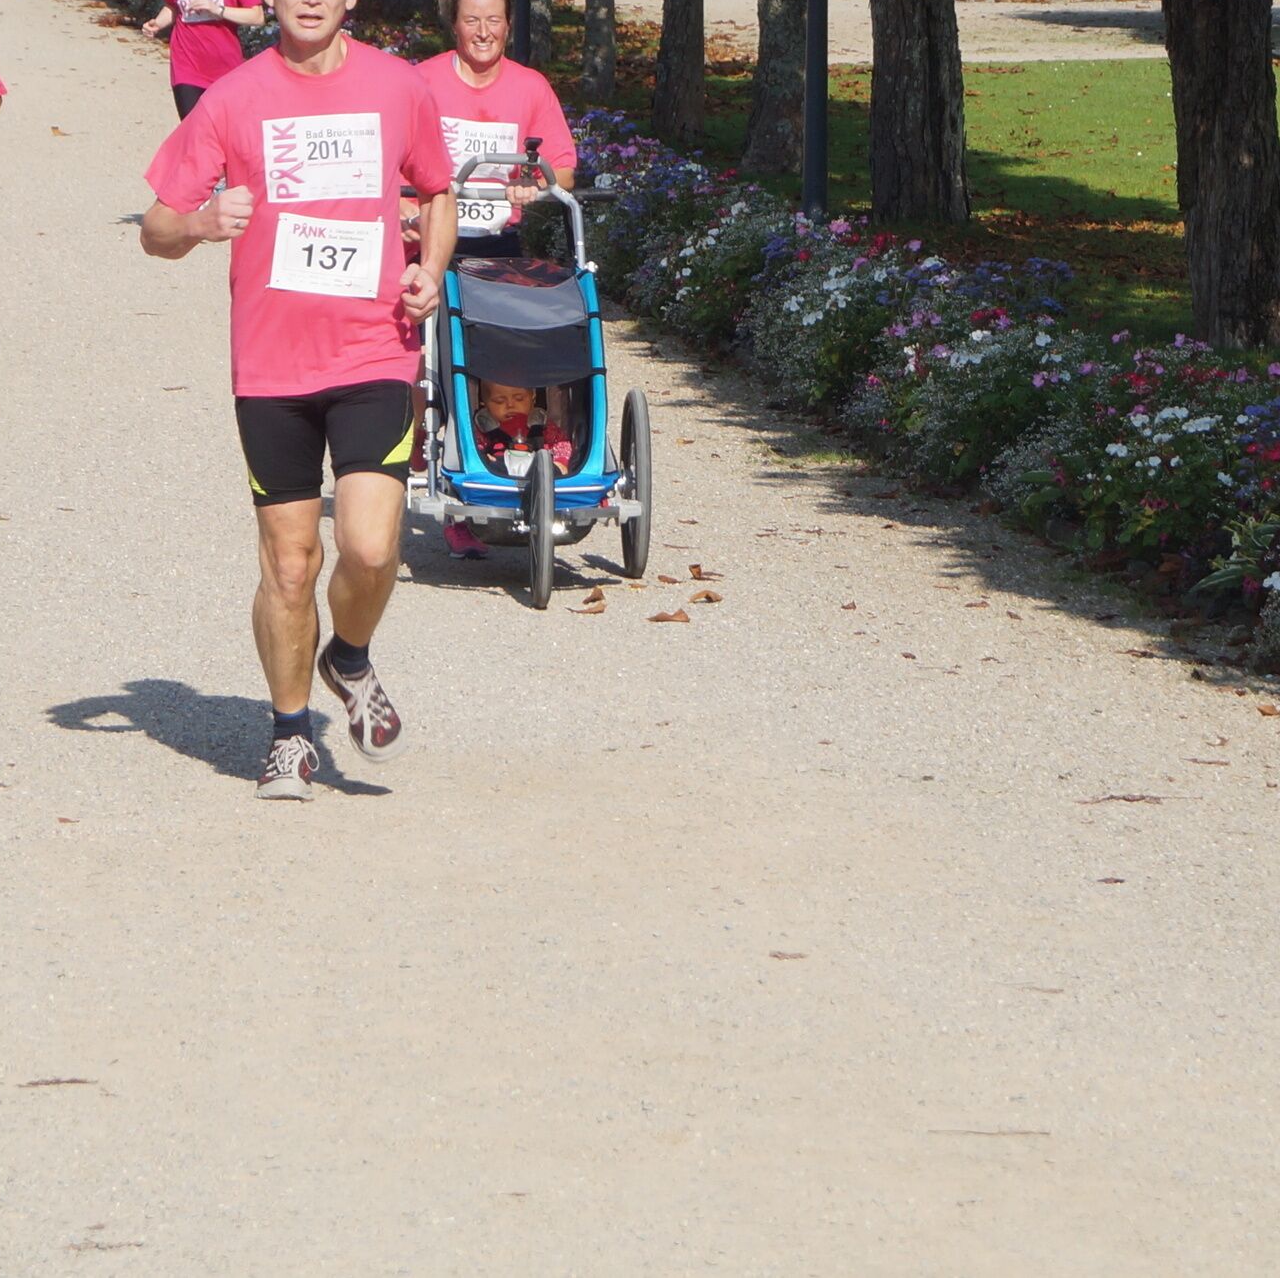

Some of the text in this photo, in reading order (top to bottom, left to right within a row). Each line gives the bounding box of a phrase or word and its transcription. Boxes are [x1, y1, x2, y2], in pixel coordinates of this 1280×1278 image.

[305, 130, 324, 139] Bad
[306, 139, 354, 160] 2014
[464, 138, 498, 154] 2014
[269, 121, 306, 199] PINK
[292, 223, 327, 239] PINK
[301, 243, 358, 272] 137
